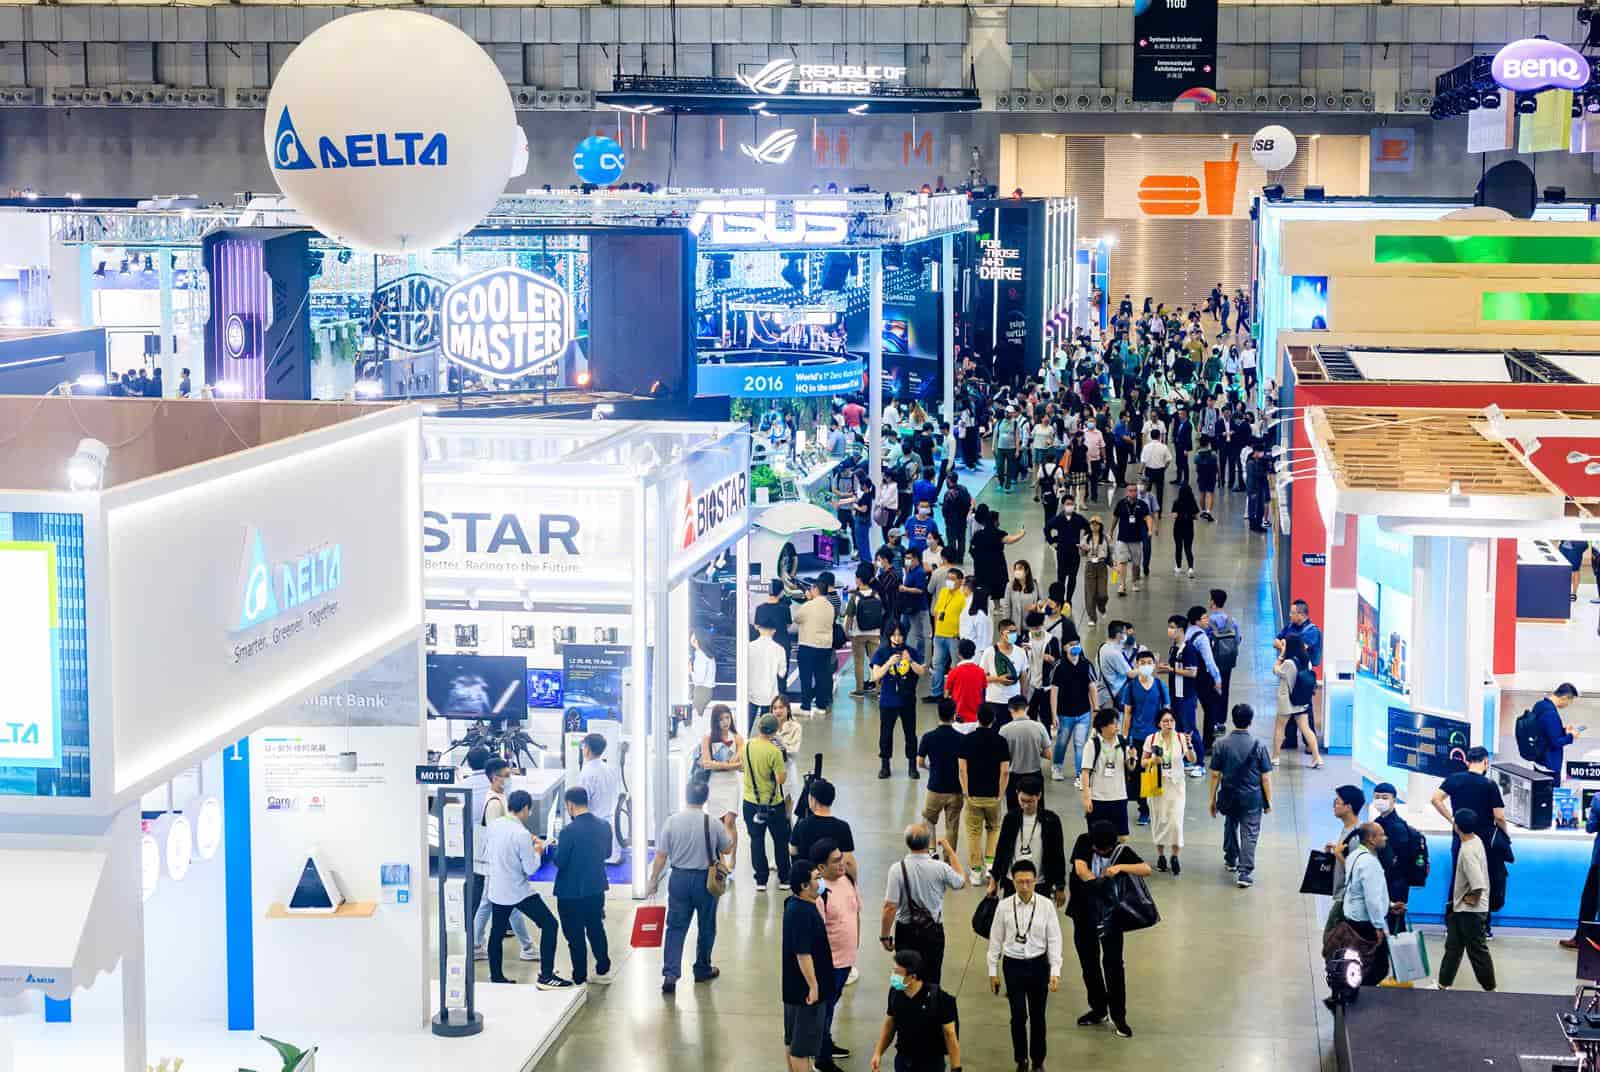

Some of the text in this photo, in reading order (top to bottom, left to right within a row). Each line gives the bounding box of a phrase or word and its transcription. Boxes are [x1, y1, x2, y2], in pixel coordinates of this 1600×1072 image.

[800, 65, 907, 80] REPUBLIC OF
[1503, 58, 1581, 80] BenQ
[800, 81, 871, 95] GAMERS
[318, 132, 448, 169] DELTA
[687, 198, 849, 244] ASUS
[980, 240, 1001, 248] FOR
[985, 249, 1020, 258] THOSE
[982, 258, 1004, 266] WHO
[980, 267, 1022, 280] DARE
[450, 276, 561, 323] COOLER
[450, 322, 561, 370] MASTER
[744, 376, 784, 391] 2016
[795, 372, 822, 382] World's
[795, 384, 808, 394] HQ
[697, 472, 746, 536] BIOSTAR
[283, 543, 342, 610] DELTA
[304, 693, 386, 708] mart Bank
[420, 772, 450, 781] M0110
[1570, 767, 1600, 777] M0120
